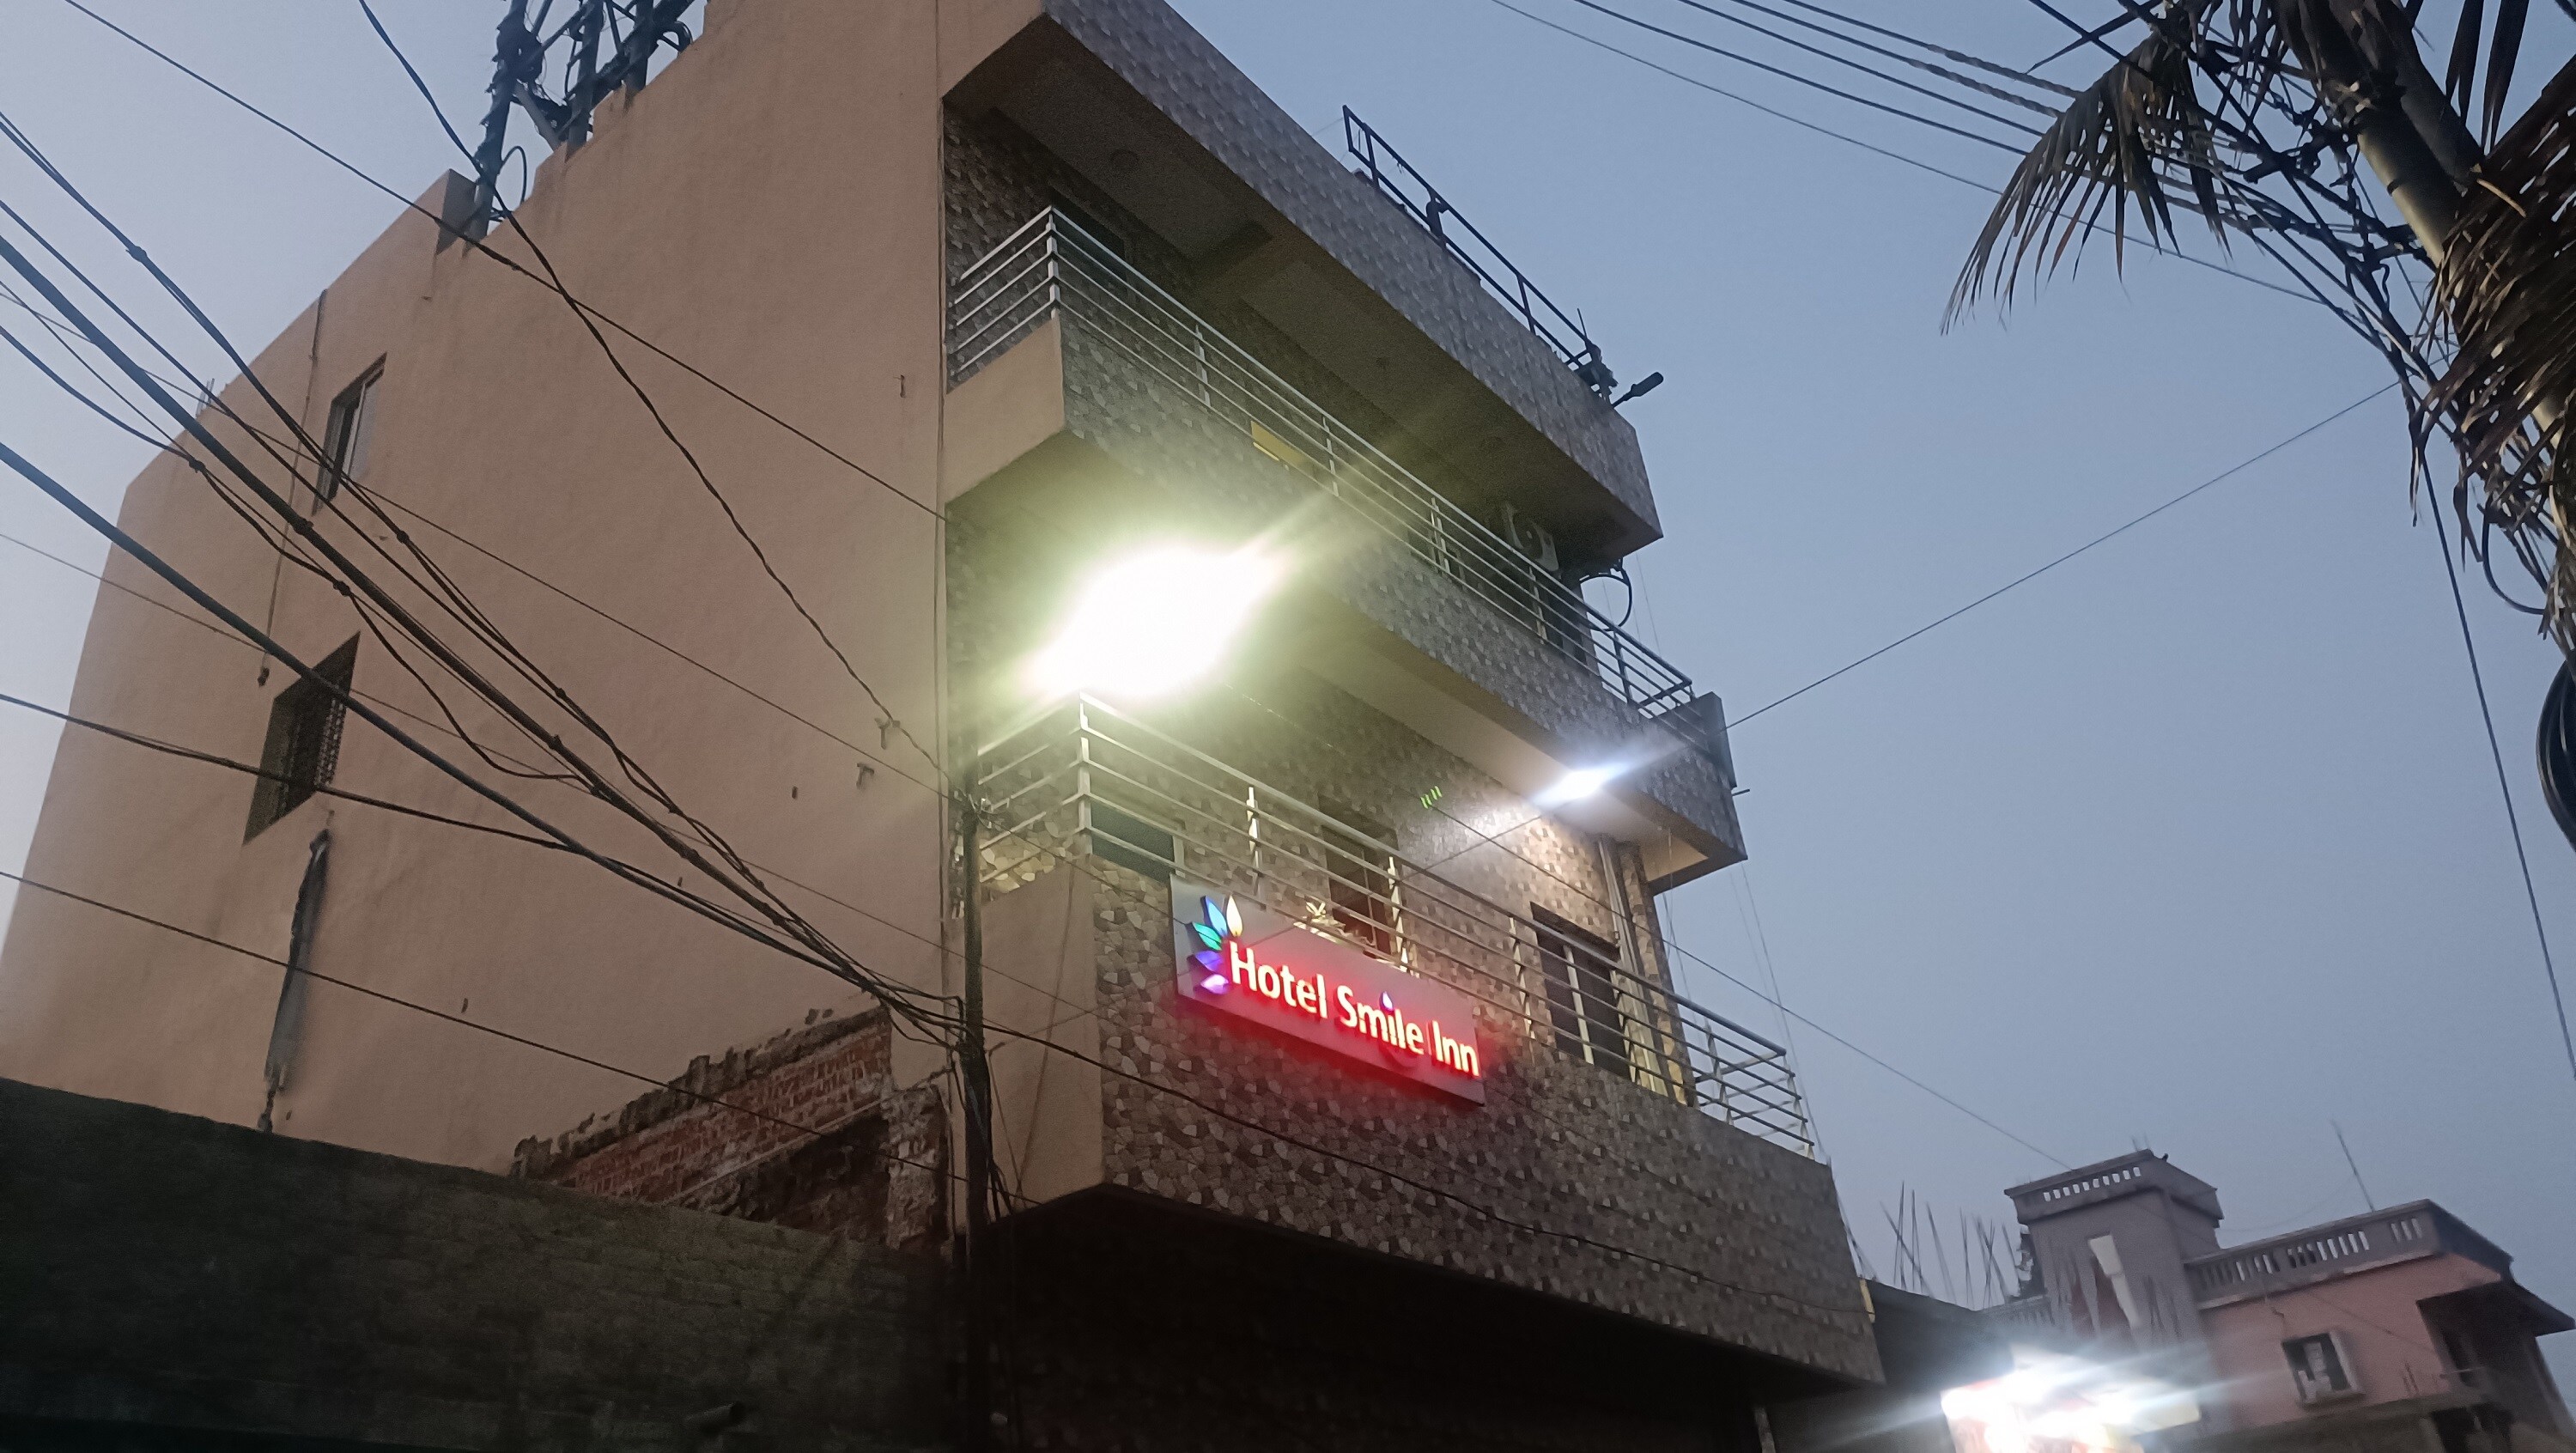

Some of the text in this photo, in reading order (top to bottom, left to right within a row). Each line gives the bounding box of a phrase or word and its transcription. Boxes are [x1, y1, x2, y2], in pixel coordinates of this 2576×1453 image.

[1229, 941, 1480, 1077] Hotel Smile Inn
